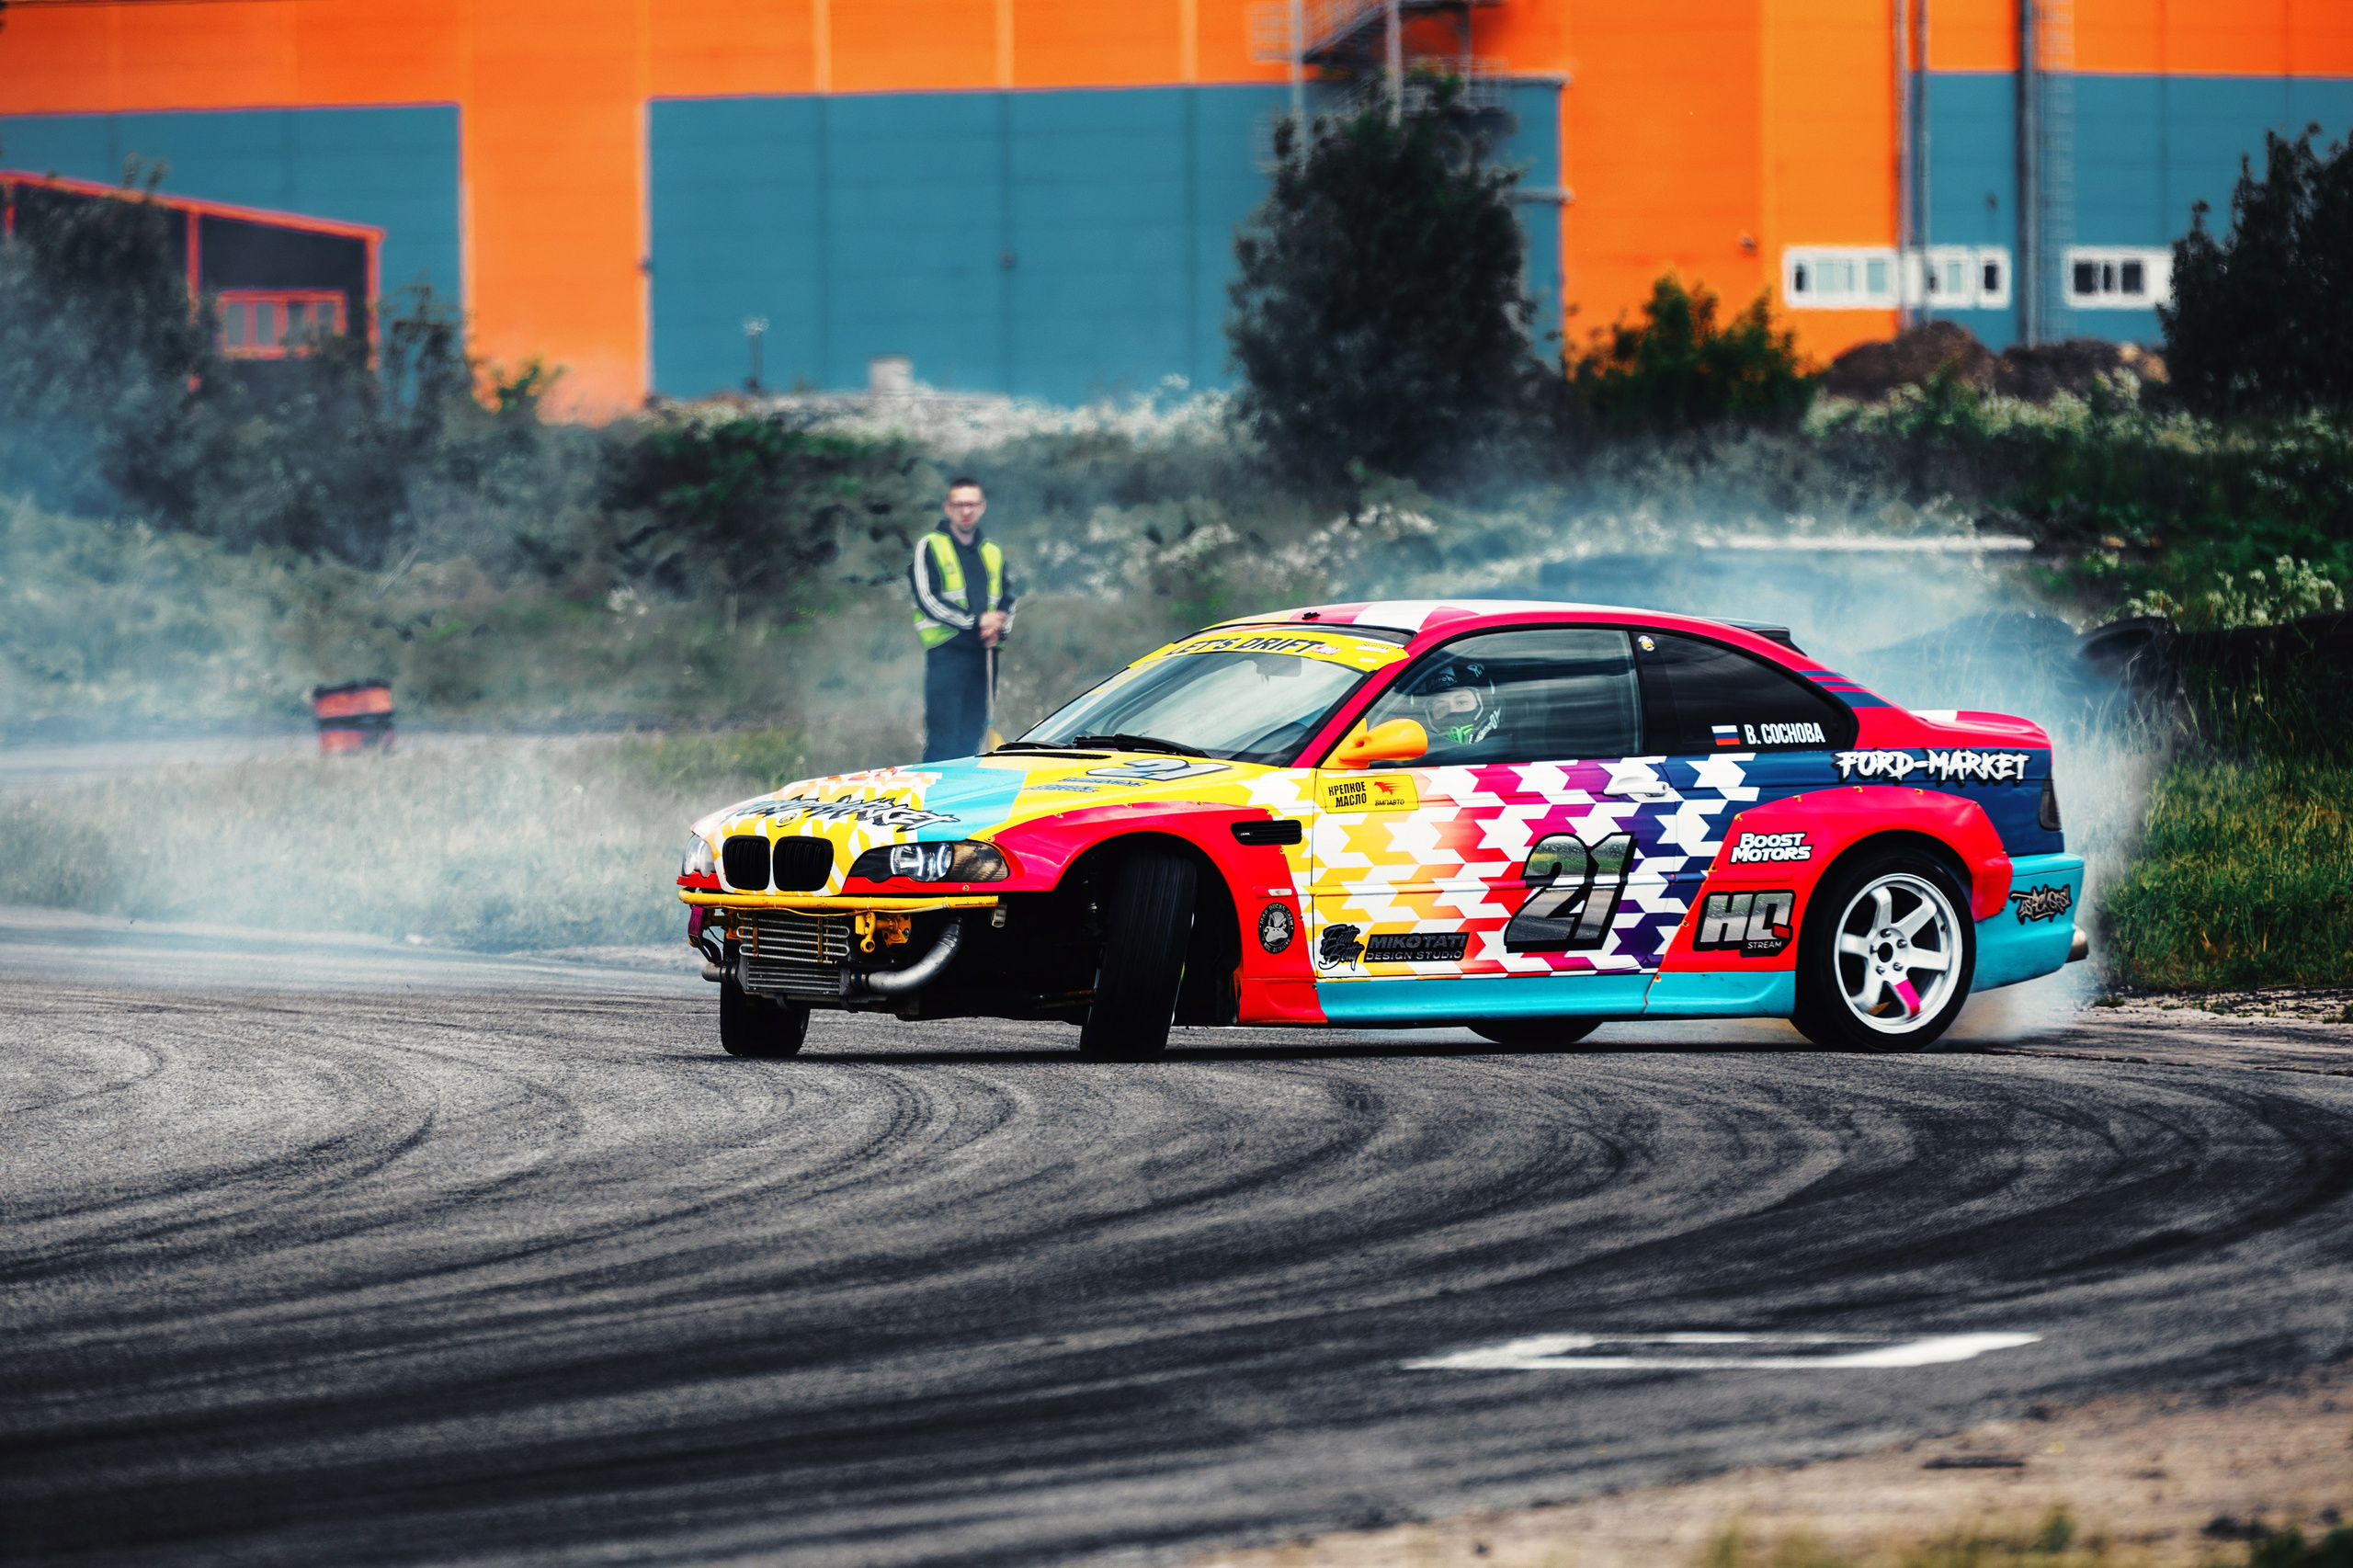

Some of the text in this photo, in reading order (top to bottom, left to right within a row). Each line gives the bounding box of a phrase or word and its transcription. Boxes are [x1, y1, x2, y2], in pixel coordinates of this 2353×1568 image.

[1086, 757, 1233, 781] 21
[1835, 748, 2030, 781] FORD-MARKET
[1327, 781, 1367, 797] КРЕПКОЕ
[1335, 792, 1368, 808] МАСЛО
[1504, 832, 1634, 949] 21
[1370, 934, 1467, 949] MIKOTATI
[1747, 940, 1783, 949] STREAM
[1366, 950, 1462, 960] DESIGN STUDIO
